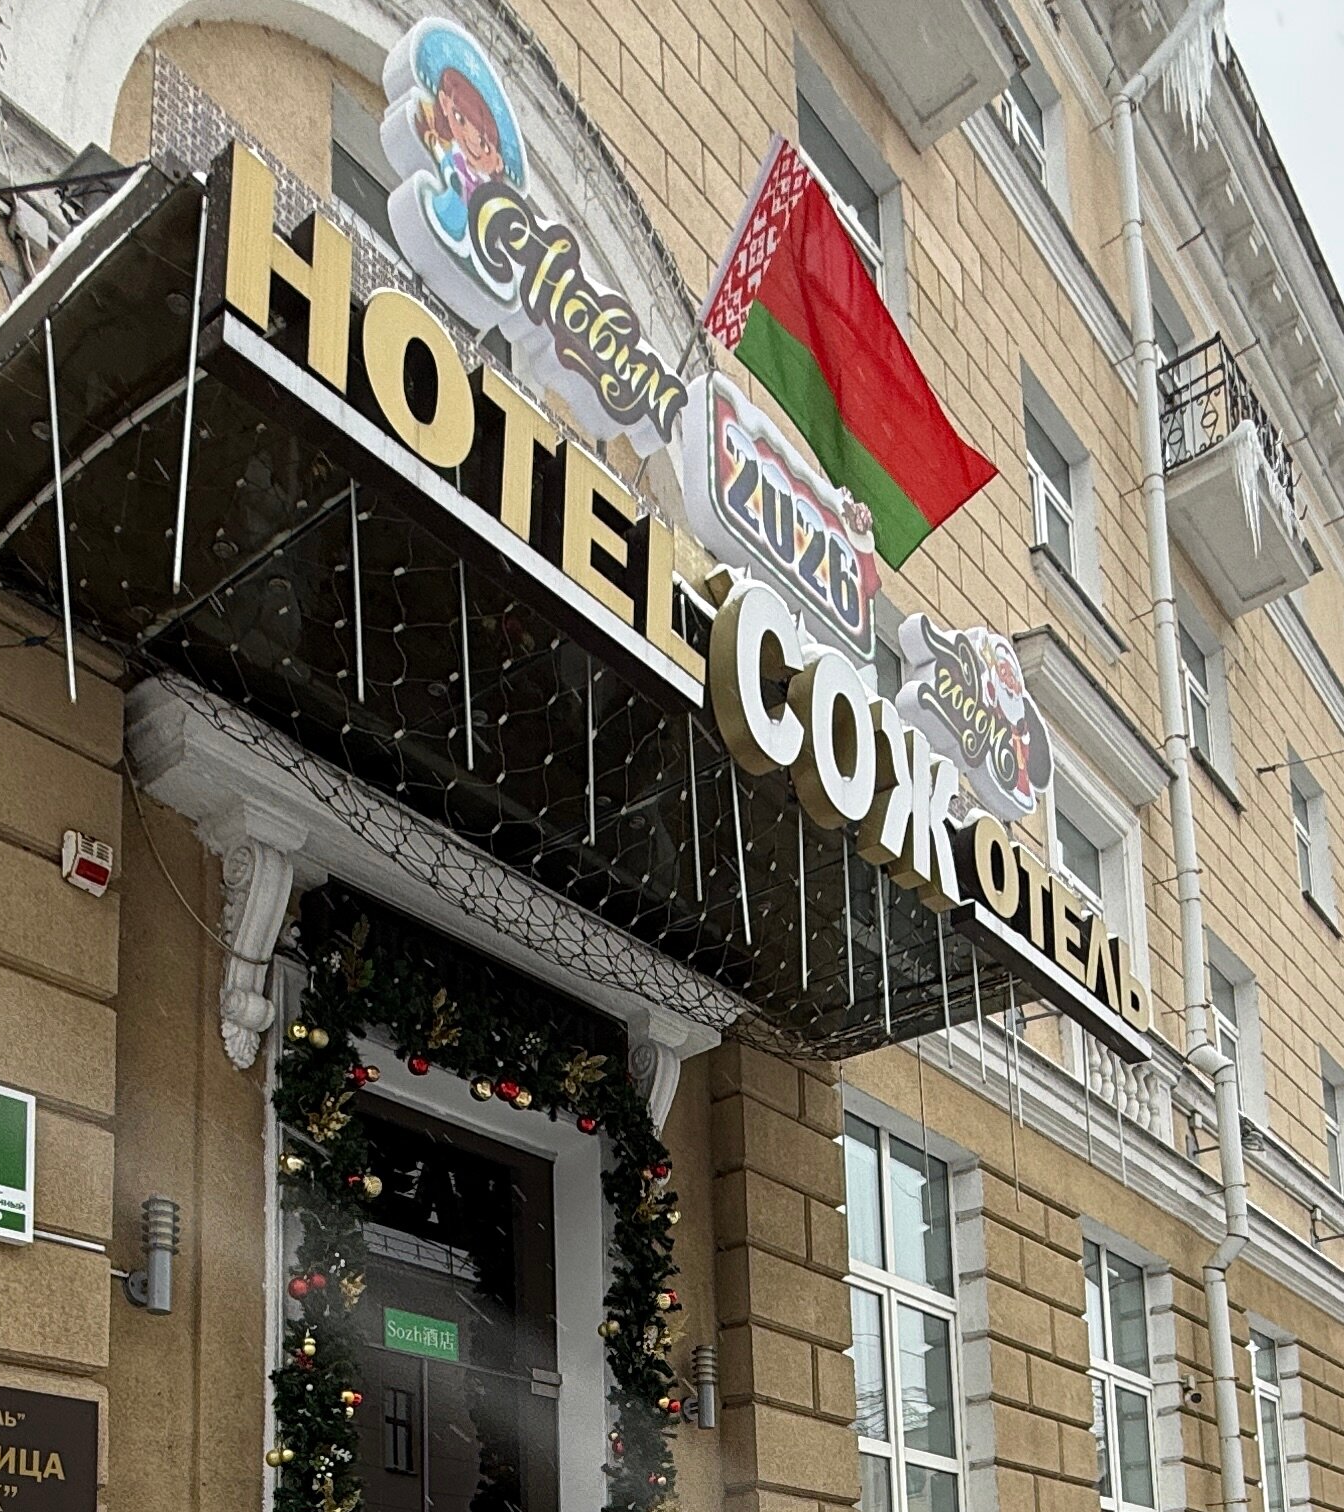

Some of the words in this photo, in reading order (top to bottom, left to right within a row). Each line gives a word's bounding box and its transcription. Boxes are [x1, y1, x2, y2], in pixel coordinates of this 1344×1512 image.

[225, 142, 706, 686] HOTEL
[528, 238, 680, 429] Новым
[726, 424, 861, 627] 2026
[737, 586, 960, 906] СОЖ
[975, 815, 1150, 1033] ОТЕЛЬ
